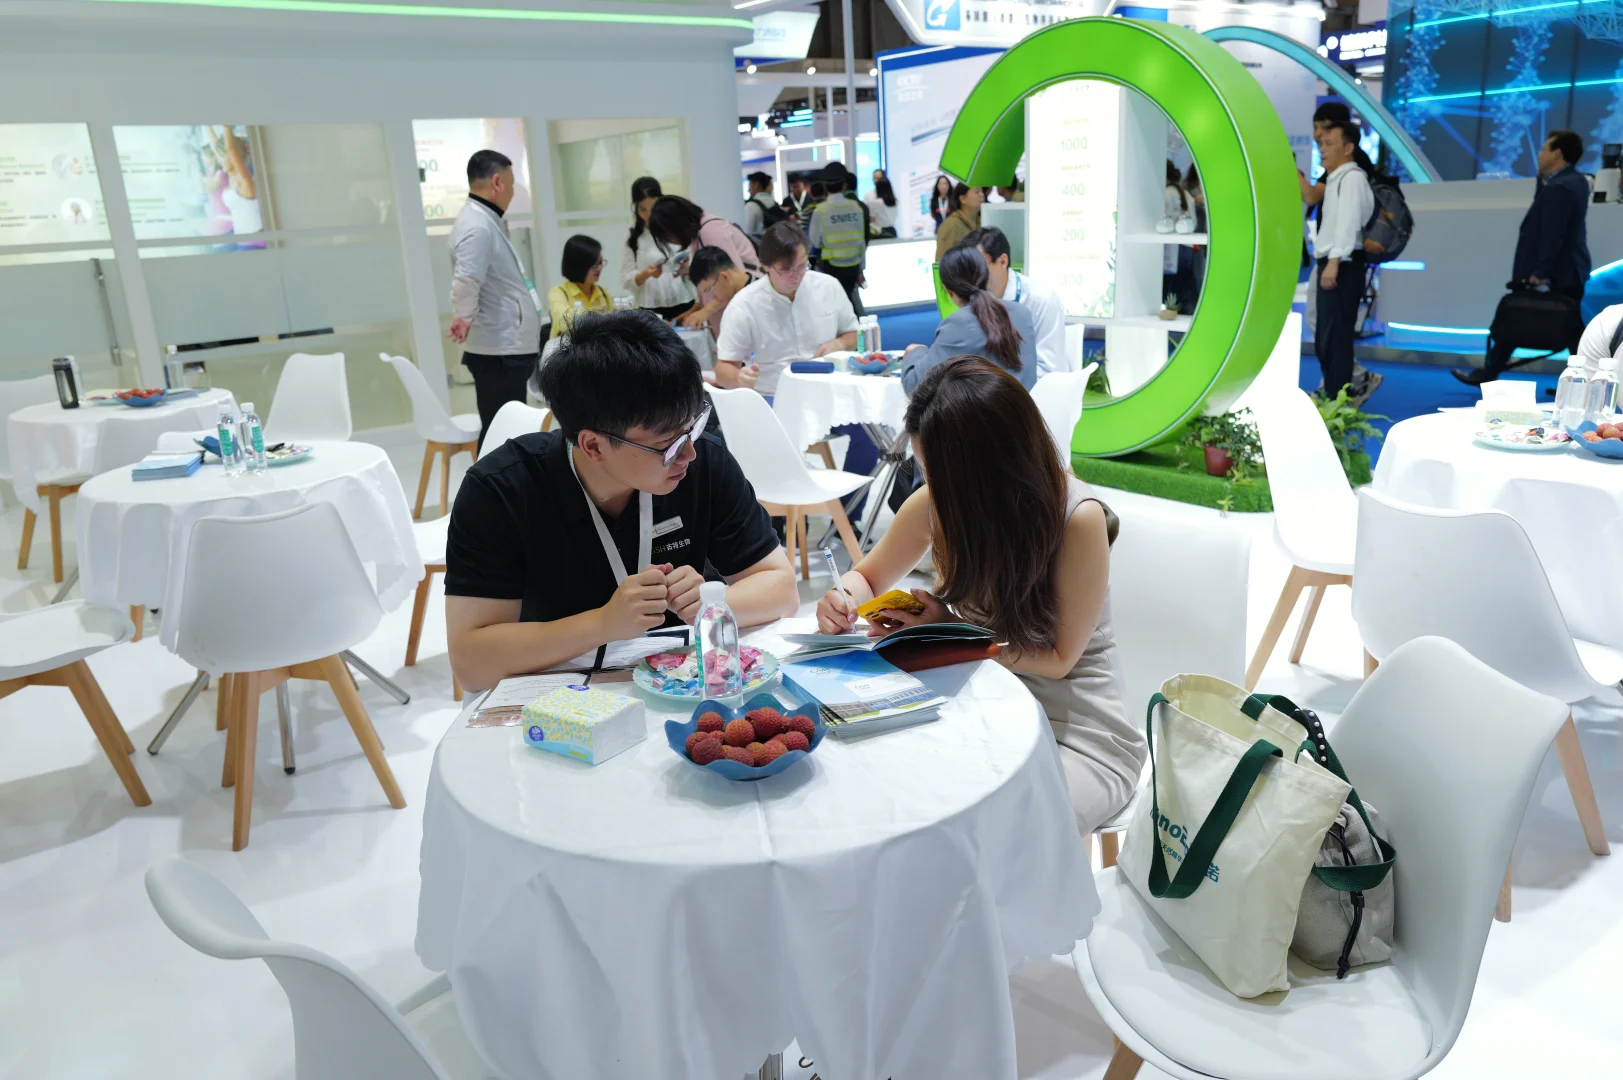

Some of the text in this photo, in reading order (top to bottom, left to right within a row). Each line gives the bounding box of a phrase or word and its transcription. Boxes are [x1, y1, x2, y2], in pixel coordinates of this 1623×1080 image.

[1061, 136, 1088, 151] 1000
[1062, 183, 1085, 196] 400
[830, 213, 859, 224] SNIEC
[1062, 229, 1085, 242] 200
